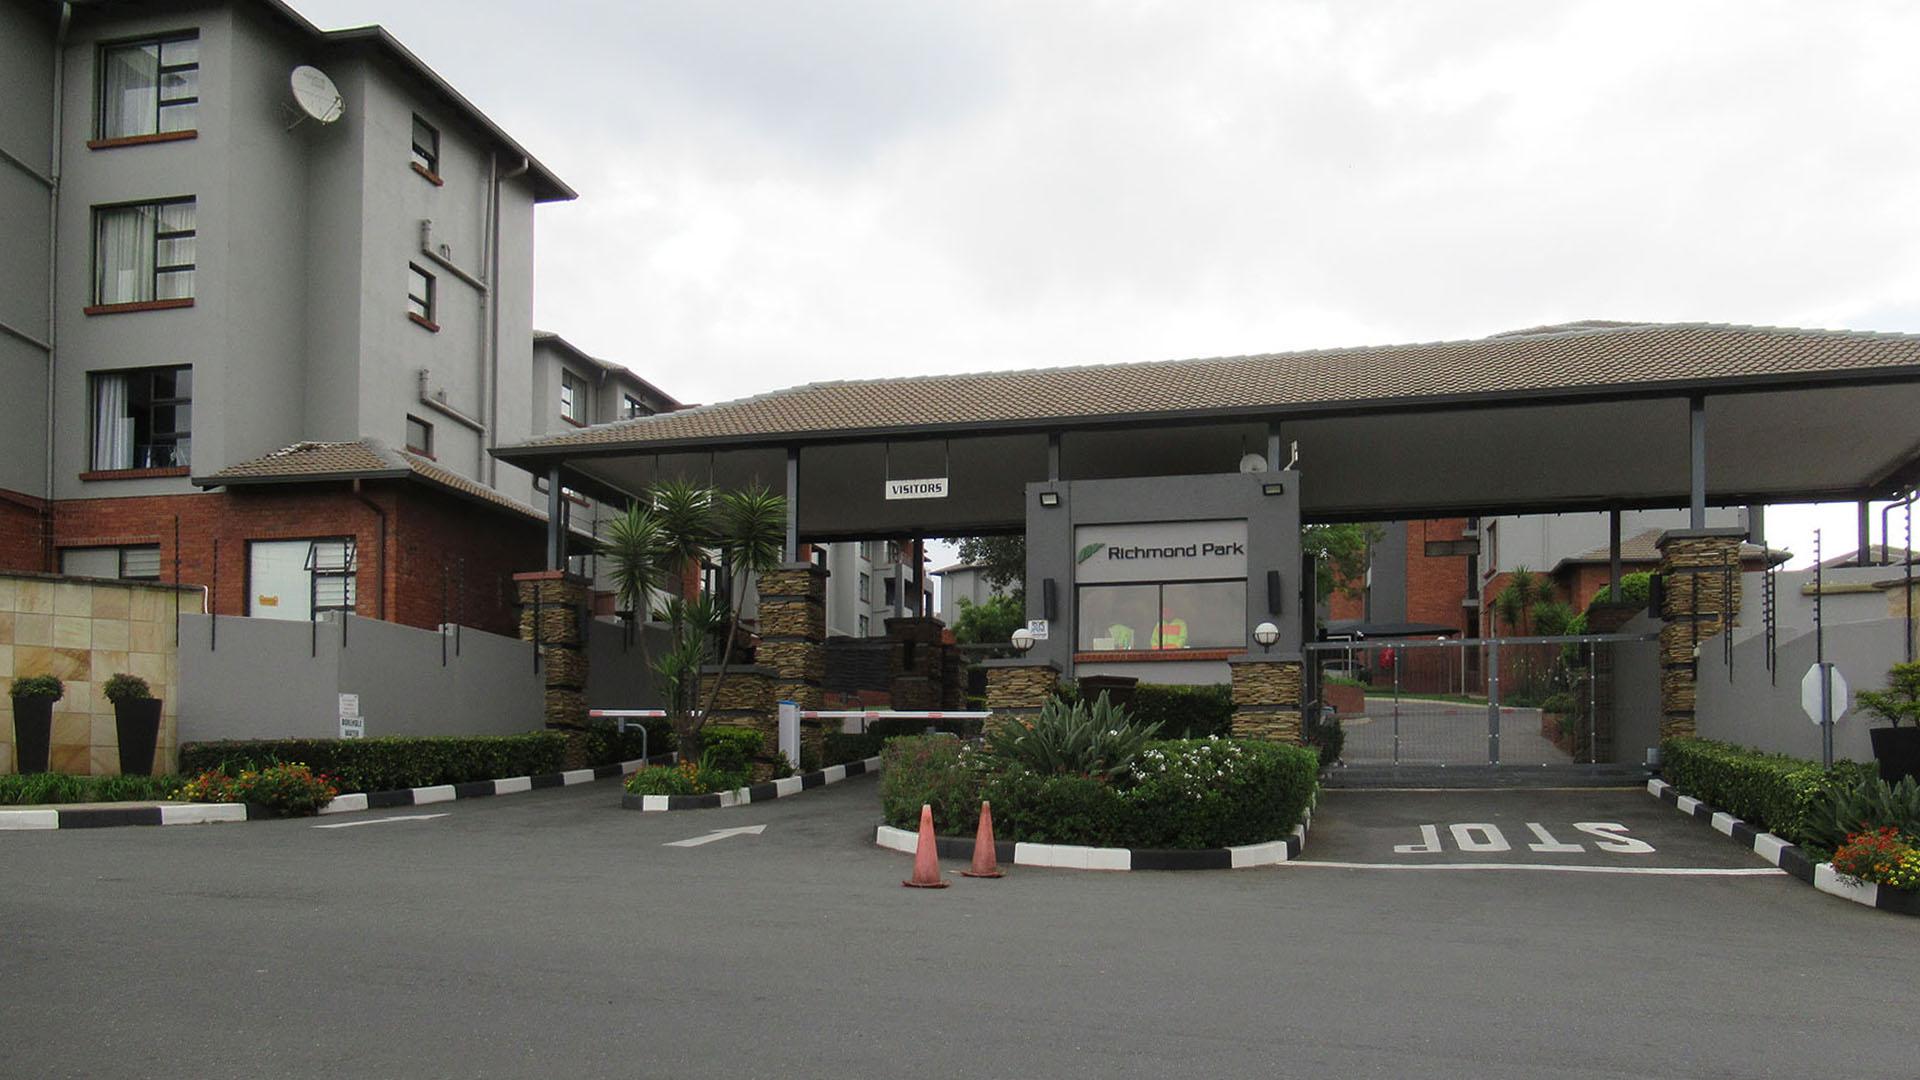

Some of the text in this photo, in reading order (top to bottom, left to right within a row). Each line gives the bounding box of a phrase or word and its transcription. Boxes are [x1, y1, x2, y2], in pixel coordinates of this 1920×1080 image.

[892, 483, 942, 494] VISITORS
[1108, 542, 1244, 560] Richmond Park
[1394, 822, 1656, 853] STOP
